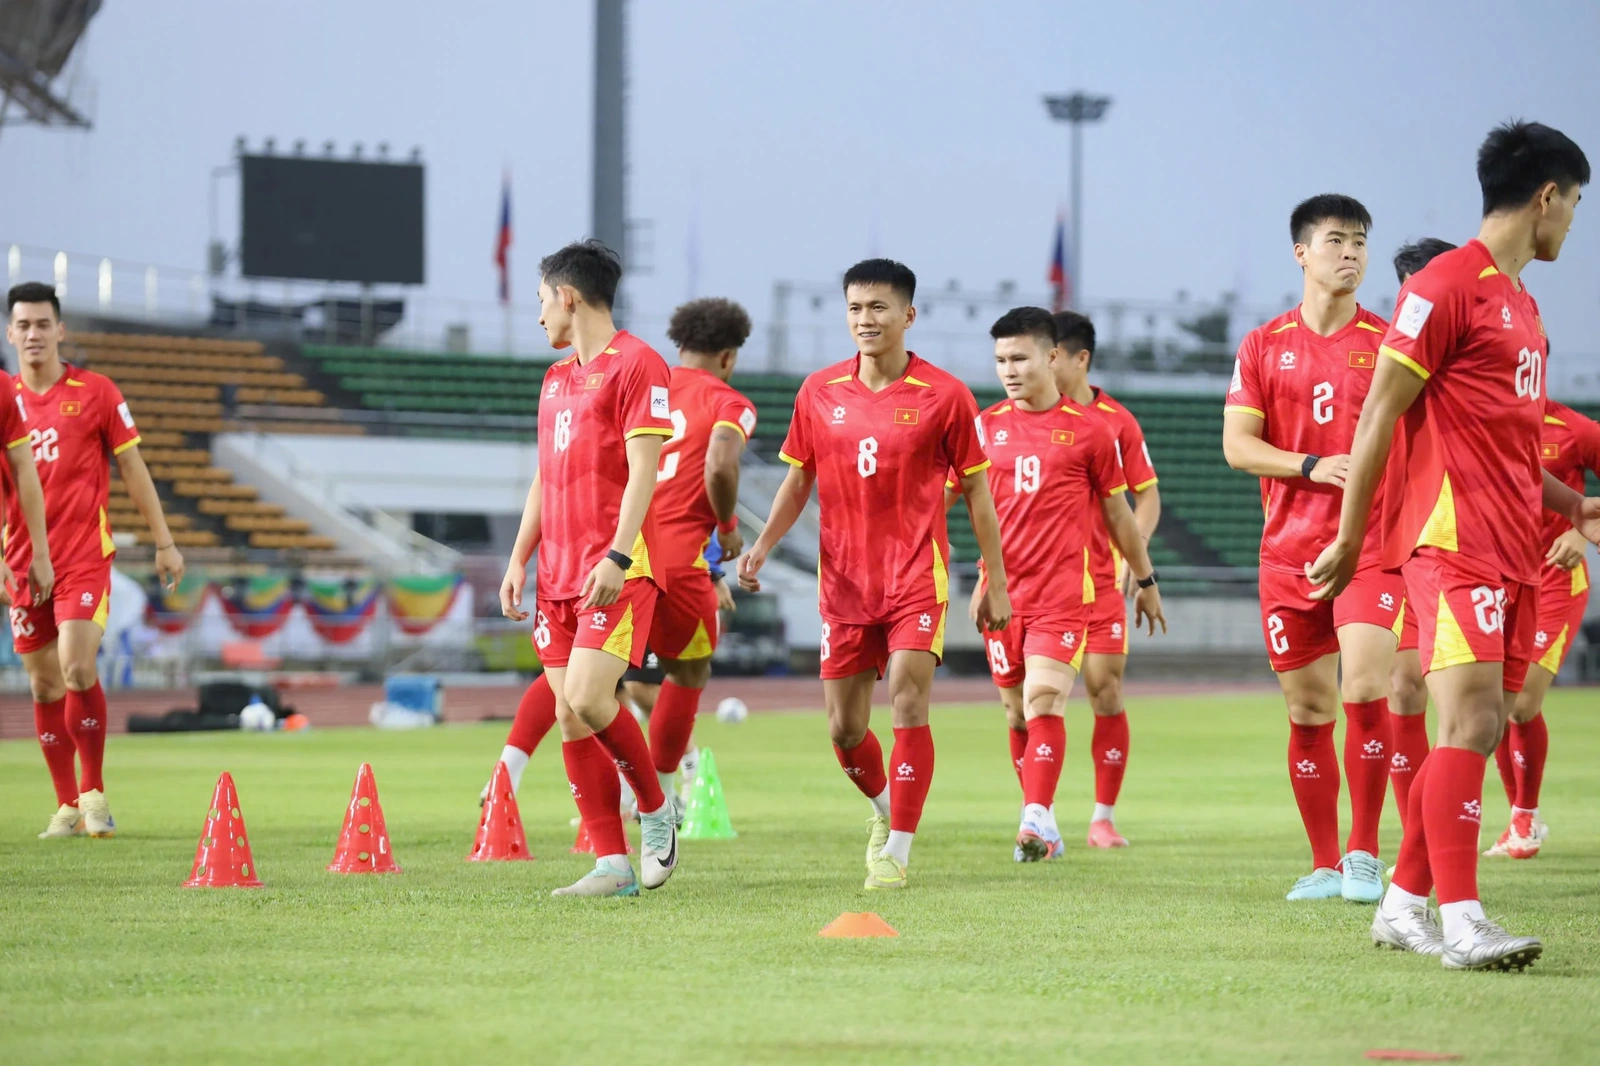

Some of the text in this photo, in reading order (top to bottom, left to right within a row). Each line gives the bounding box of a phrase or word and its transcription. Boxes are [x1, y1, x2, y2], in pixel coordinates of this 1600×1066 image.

[1515, 346, 1542, 401] 20
[1313, 380, 1334, 425] 2
[30, 427, 60, 463] 22
[553, 408, 573, 454] 18
[858, 436, 879, 479] 8
[1014, 455, 1041, 494] 19
[1267, 613, 1290, 655] 2
[988, 638, 1011, 676] 19
